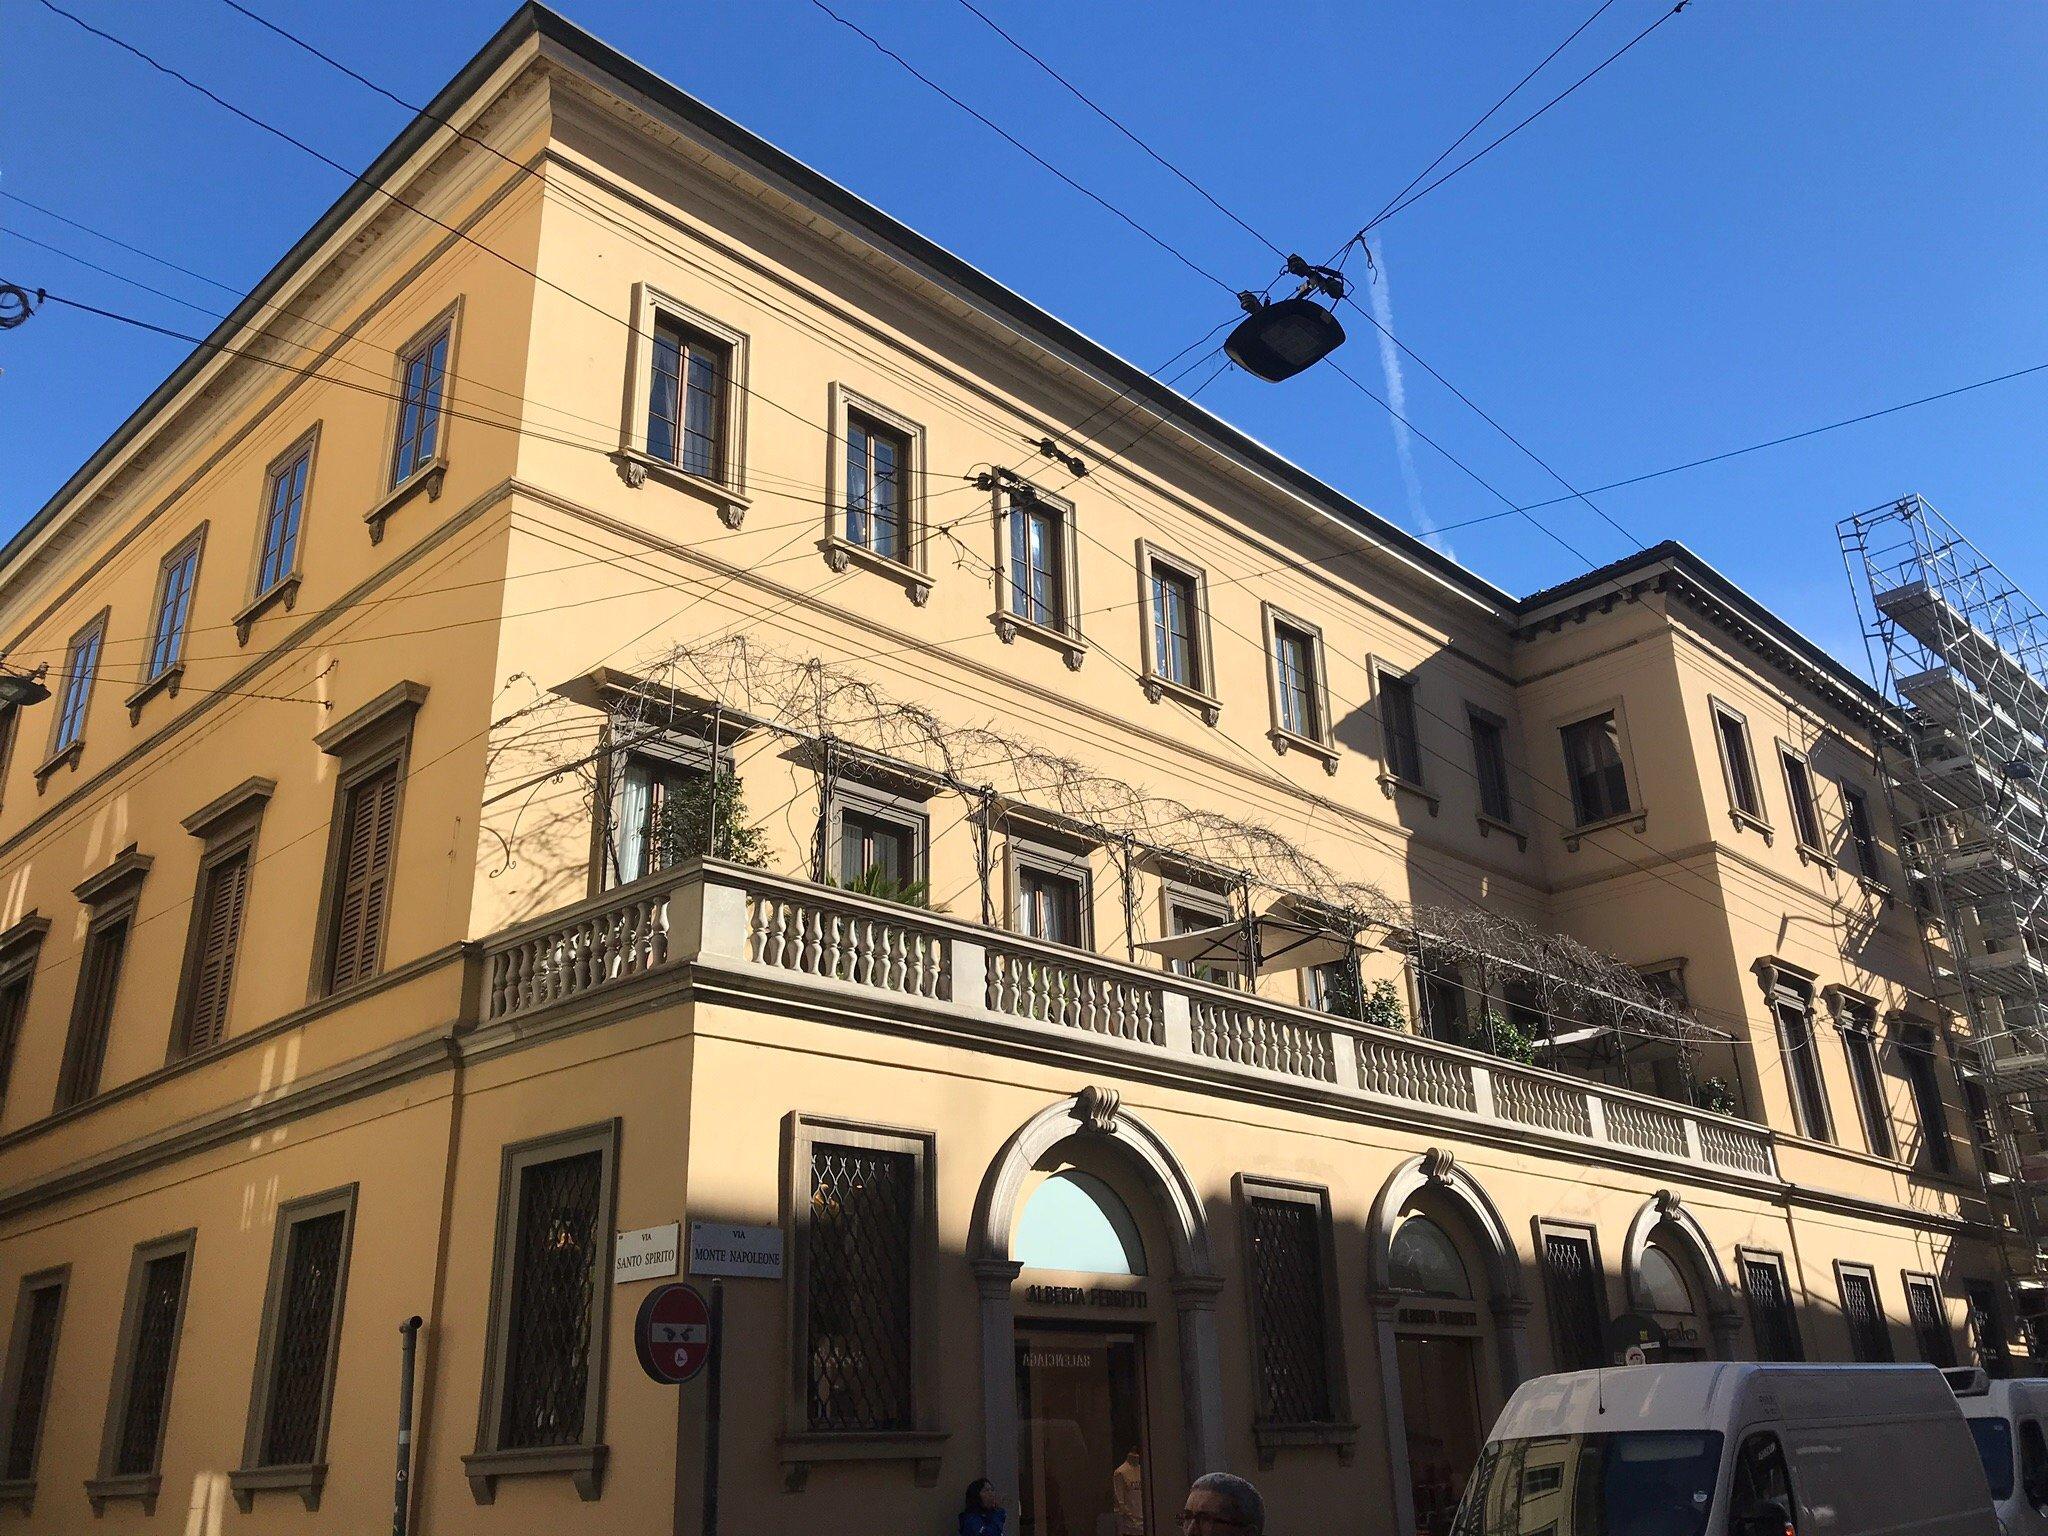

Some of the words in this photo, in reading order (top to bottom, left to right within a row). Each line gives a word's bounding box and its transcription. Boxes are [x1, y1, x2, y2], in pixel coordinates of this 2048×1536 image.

[641, 1233, 652, 1242] VIA
[733, 1230, 746, 1239] VIA
[616, 1254, 642, 1270] SANTO
[644, 1249, 675, 1265] SPIRITO
[694, 1248, 726, 1261] MONTE
[729, 1251, 780, 1266] NAPOLEONE
